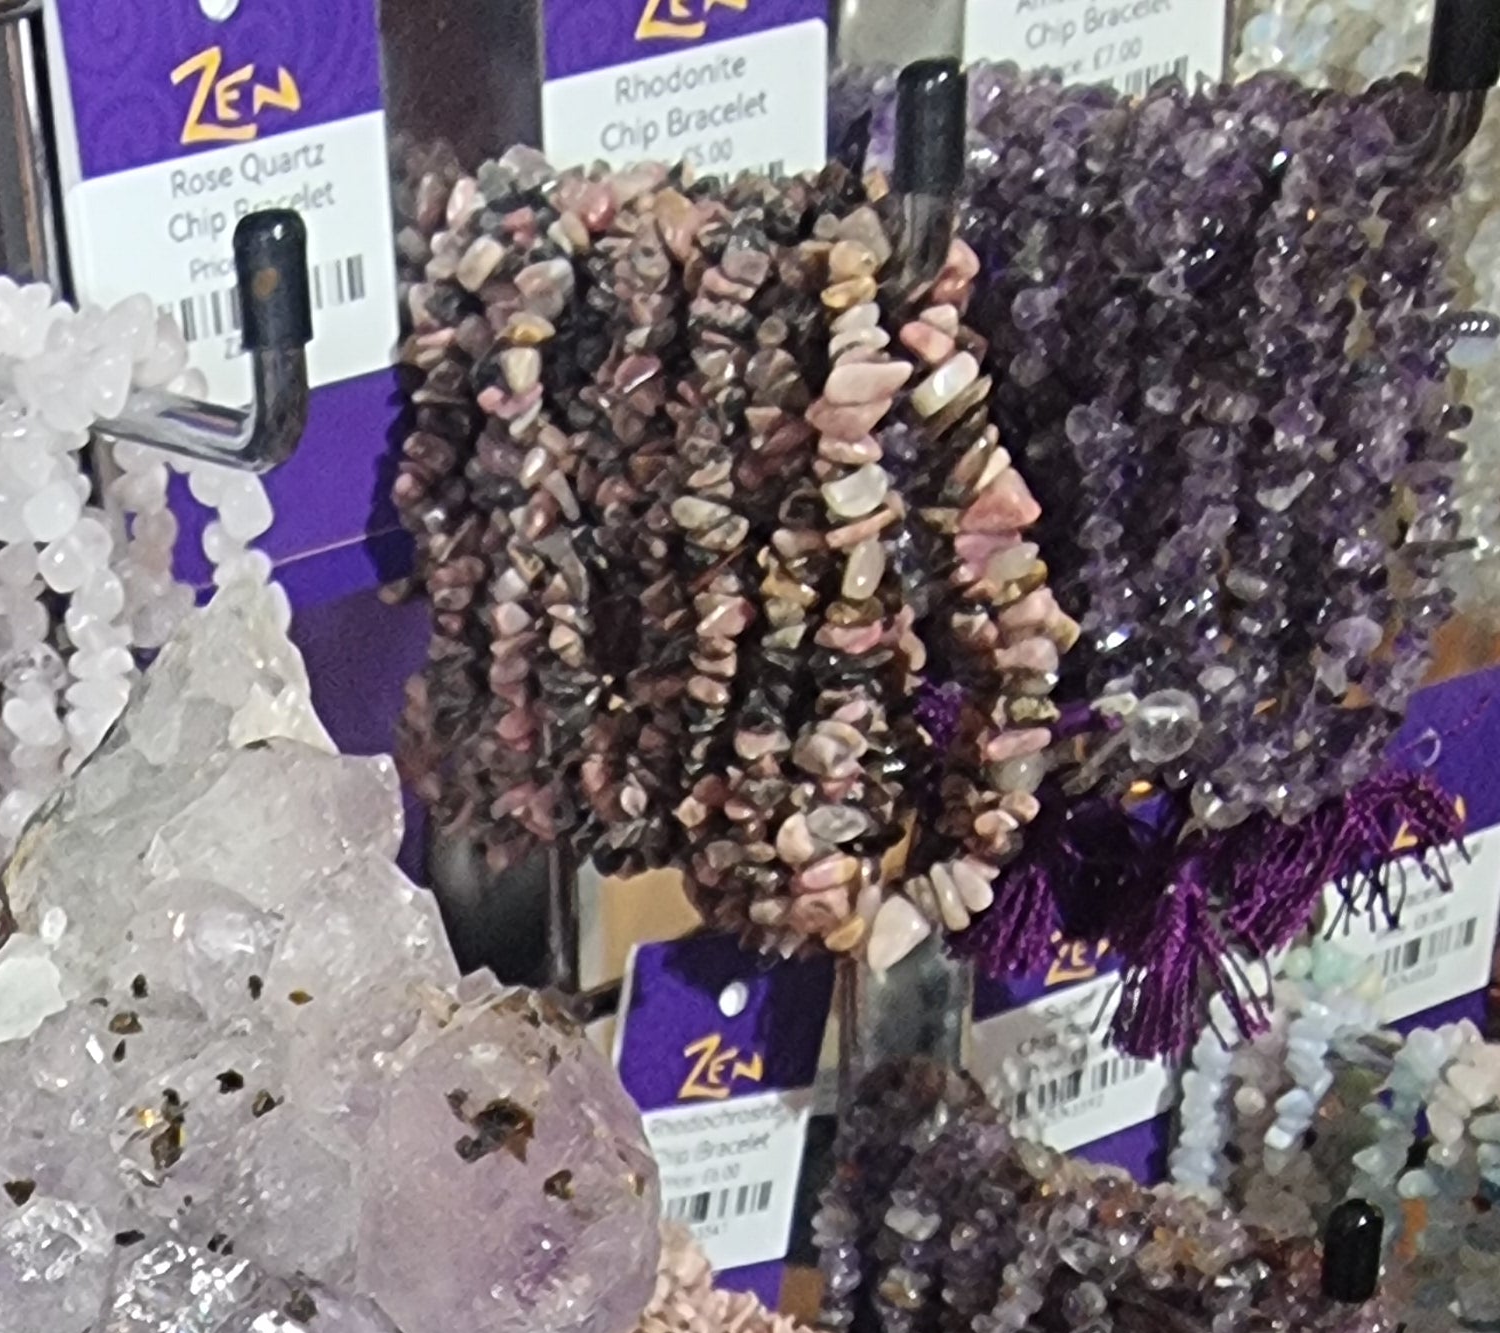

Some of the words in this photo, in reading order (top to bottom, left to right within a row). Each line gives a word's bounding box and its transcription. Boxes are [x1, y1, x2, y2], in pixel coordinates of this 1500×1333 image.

[170, 46, 300, 144] ZEN
[614, 55, 748, 105] Rhodonite
[600, 118, 658, 151] Chip
[667, 91, 768, 138] Bracelet
[170, 166, 233, 199] Rose
[240, 143, 325, 185] Quartz
[168, 210, 226, 243] Chip
[677, 1033, 763, 1099] ZEN
